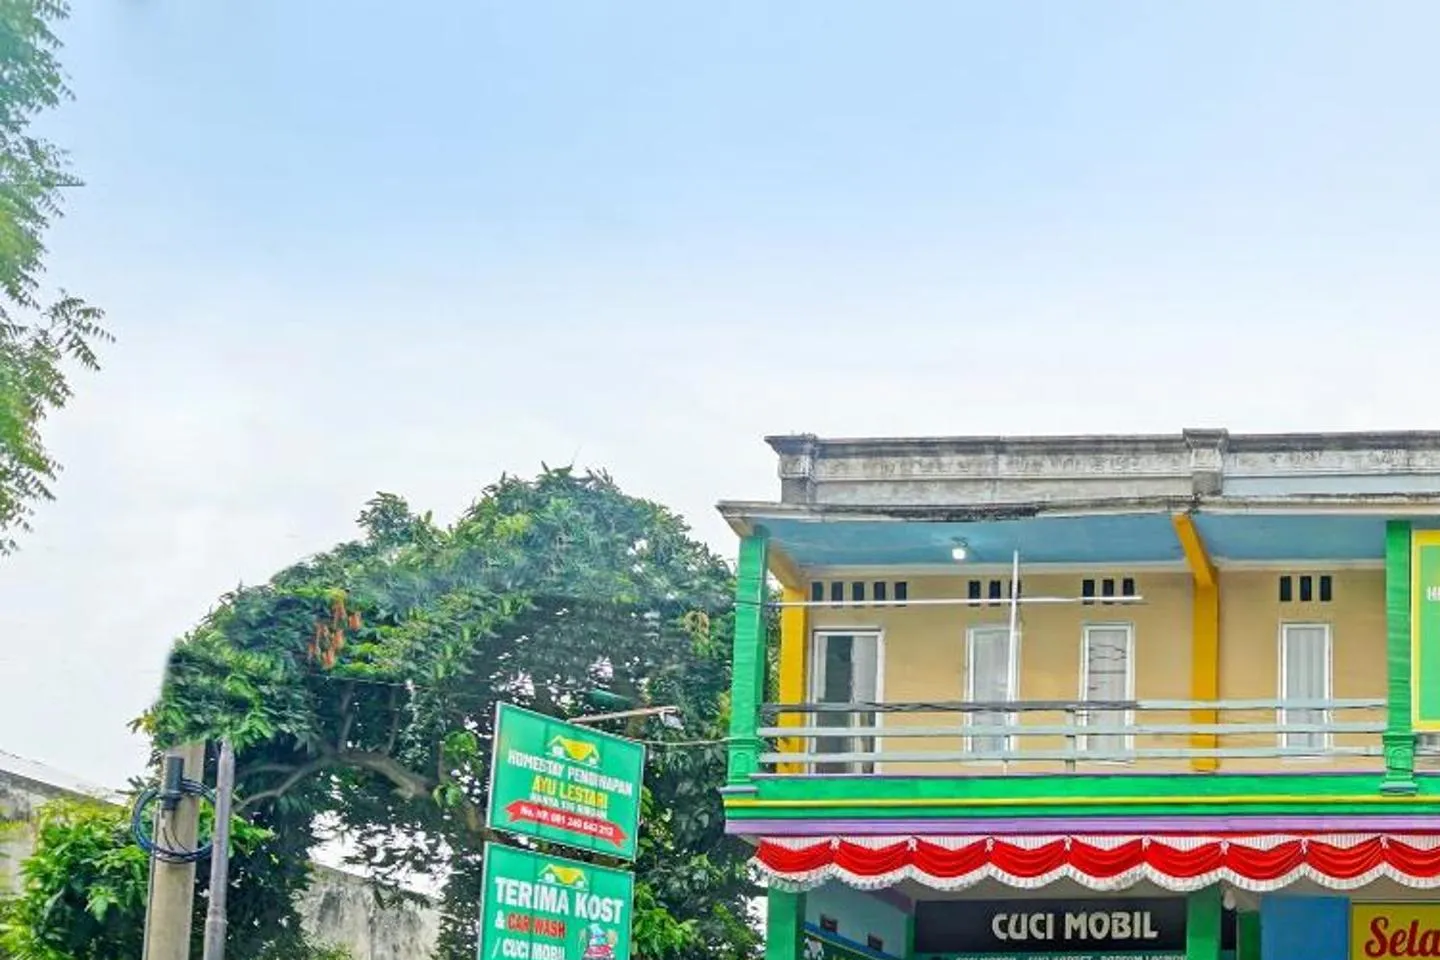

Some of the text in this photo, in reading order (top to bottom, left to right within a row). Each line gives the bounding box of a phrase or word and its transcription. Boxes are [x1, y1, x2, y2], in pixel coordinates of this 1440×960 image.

[508, 750, 632, 796] HOMESTAY PENGINAPAN
[532, 774, 556, 796] AYU
[559, 782, 607, 809] LESTARI
[495, 876, 624, 924] TERIMA KOST
[495, 910, 566, 939] & CAR WASH
[992, 911, 1159, 940] CUCI MOBIL
[502, 938, 530, 960] CUCI
